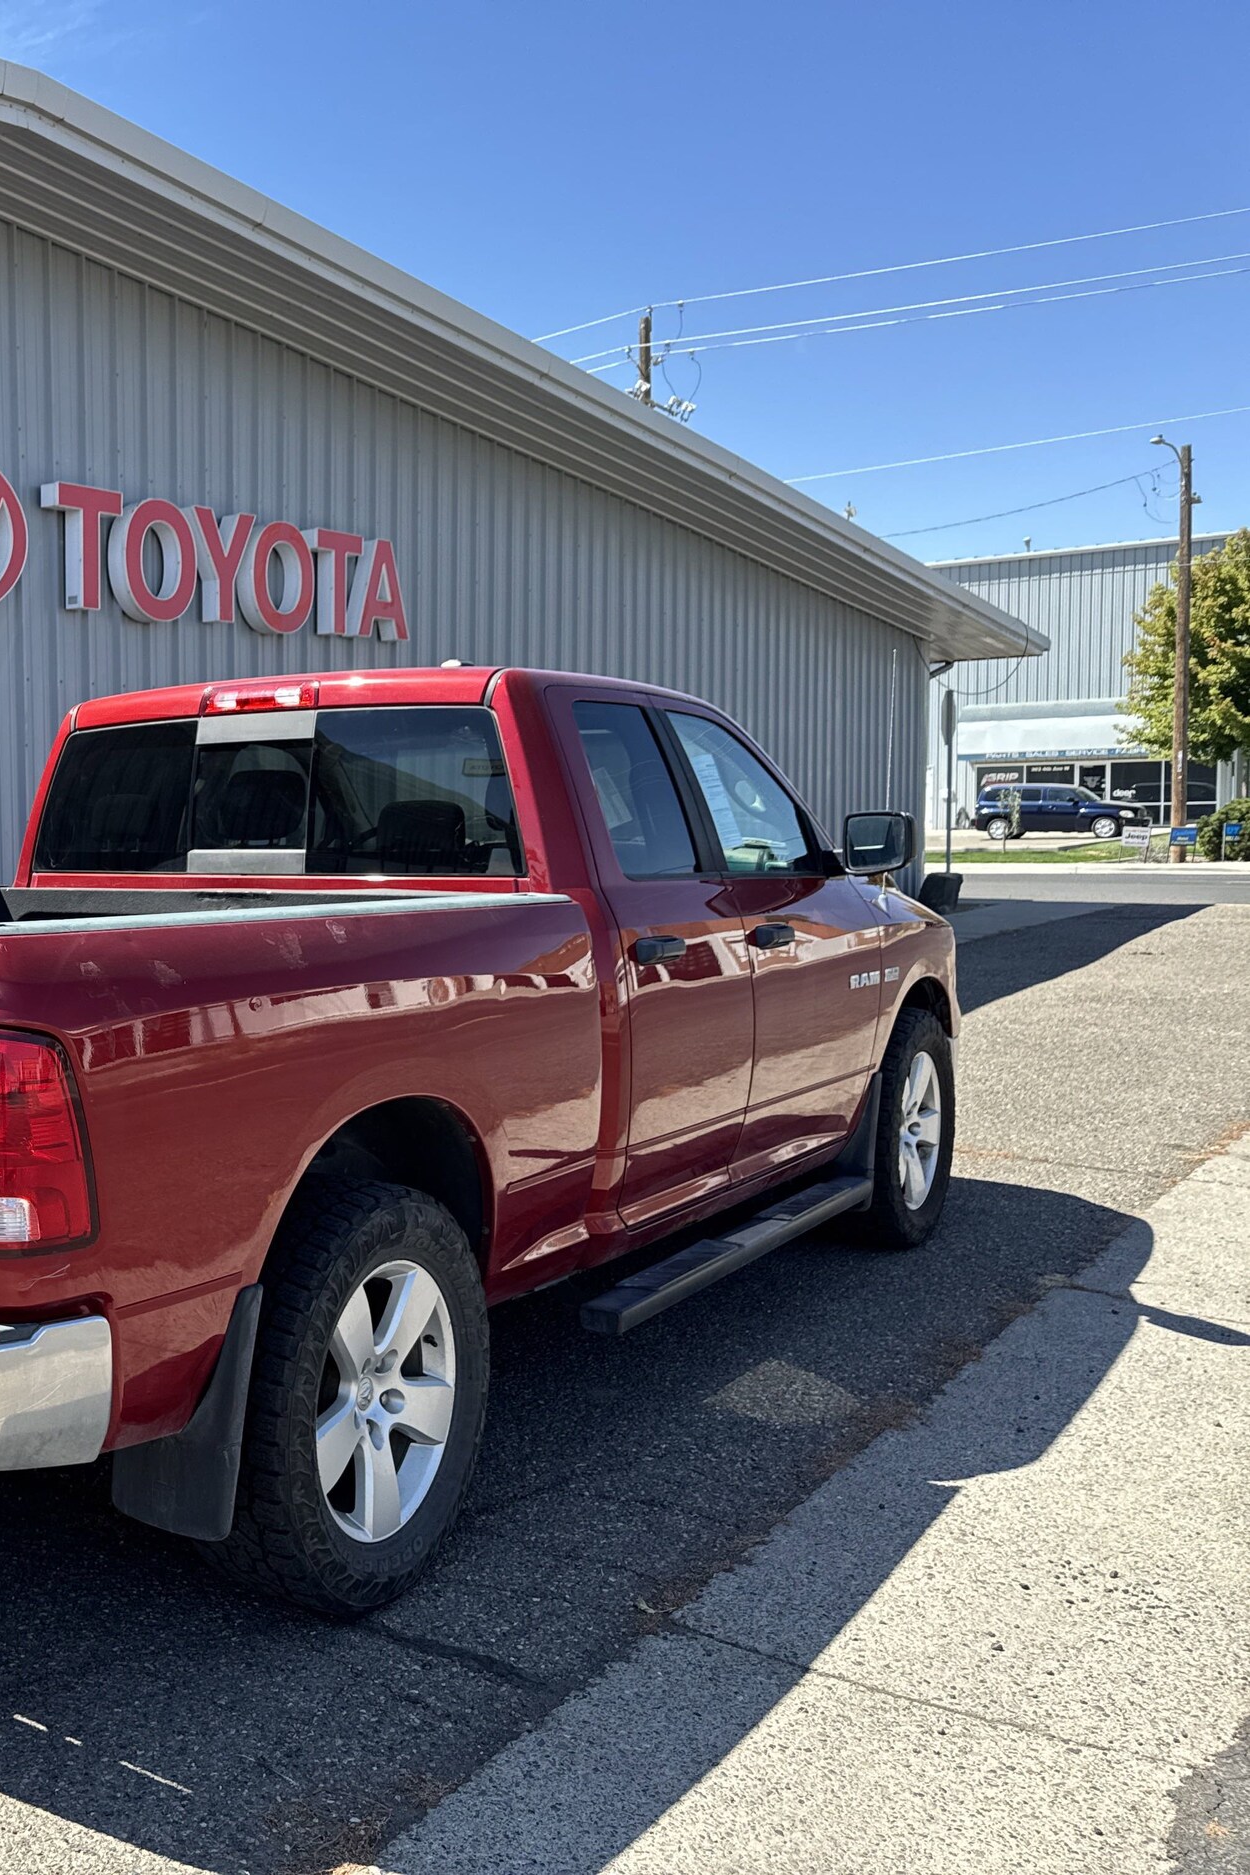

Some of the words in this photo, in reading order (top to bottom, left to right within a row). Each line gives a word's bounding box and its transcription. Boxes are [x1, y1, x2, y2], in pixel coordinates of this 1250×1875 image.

[40, 481, 410, 641] TOYOTA
[1124, 832, 1148, 841] Jeep
[850, 970, 880, 990] RAM
